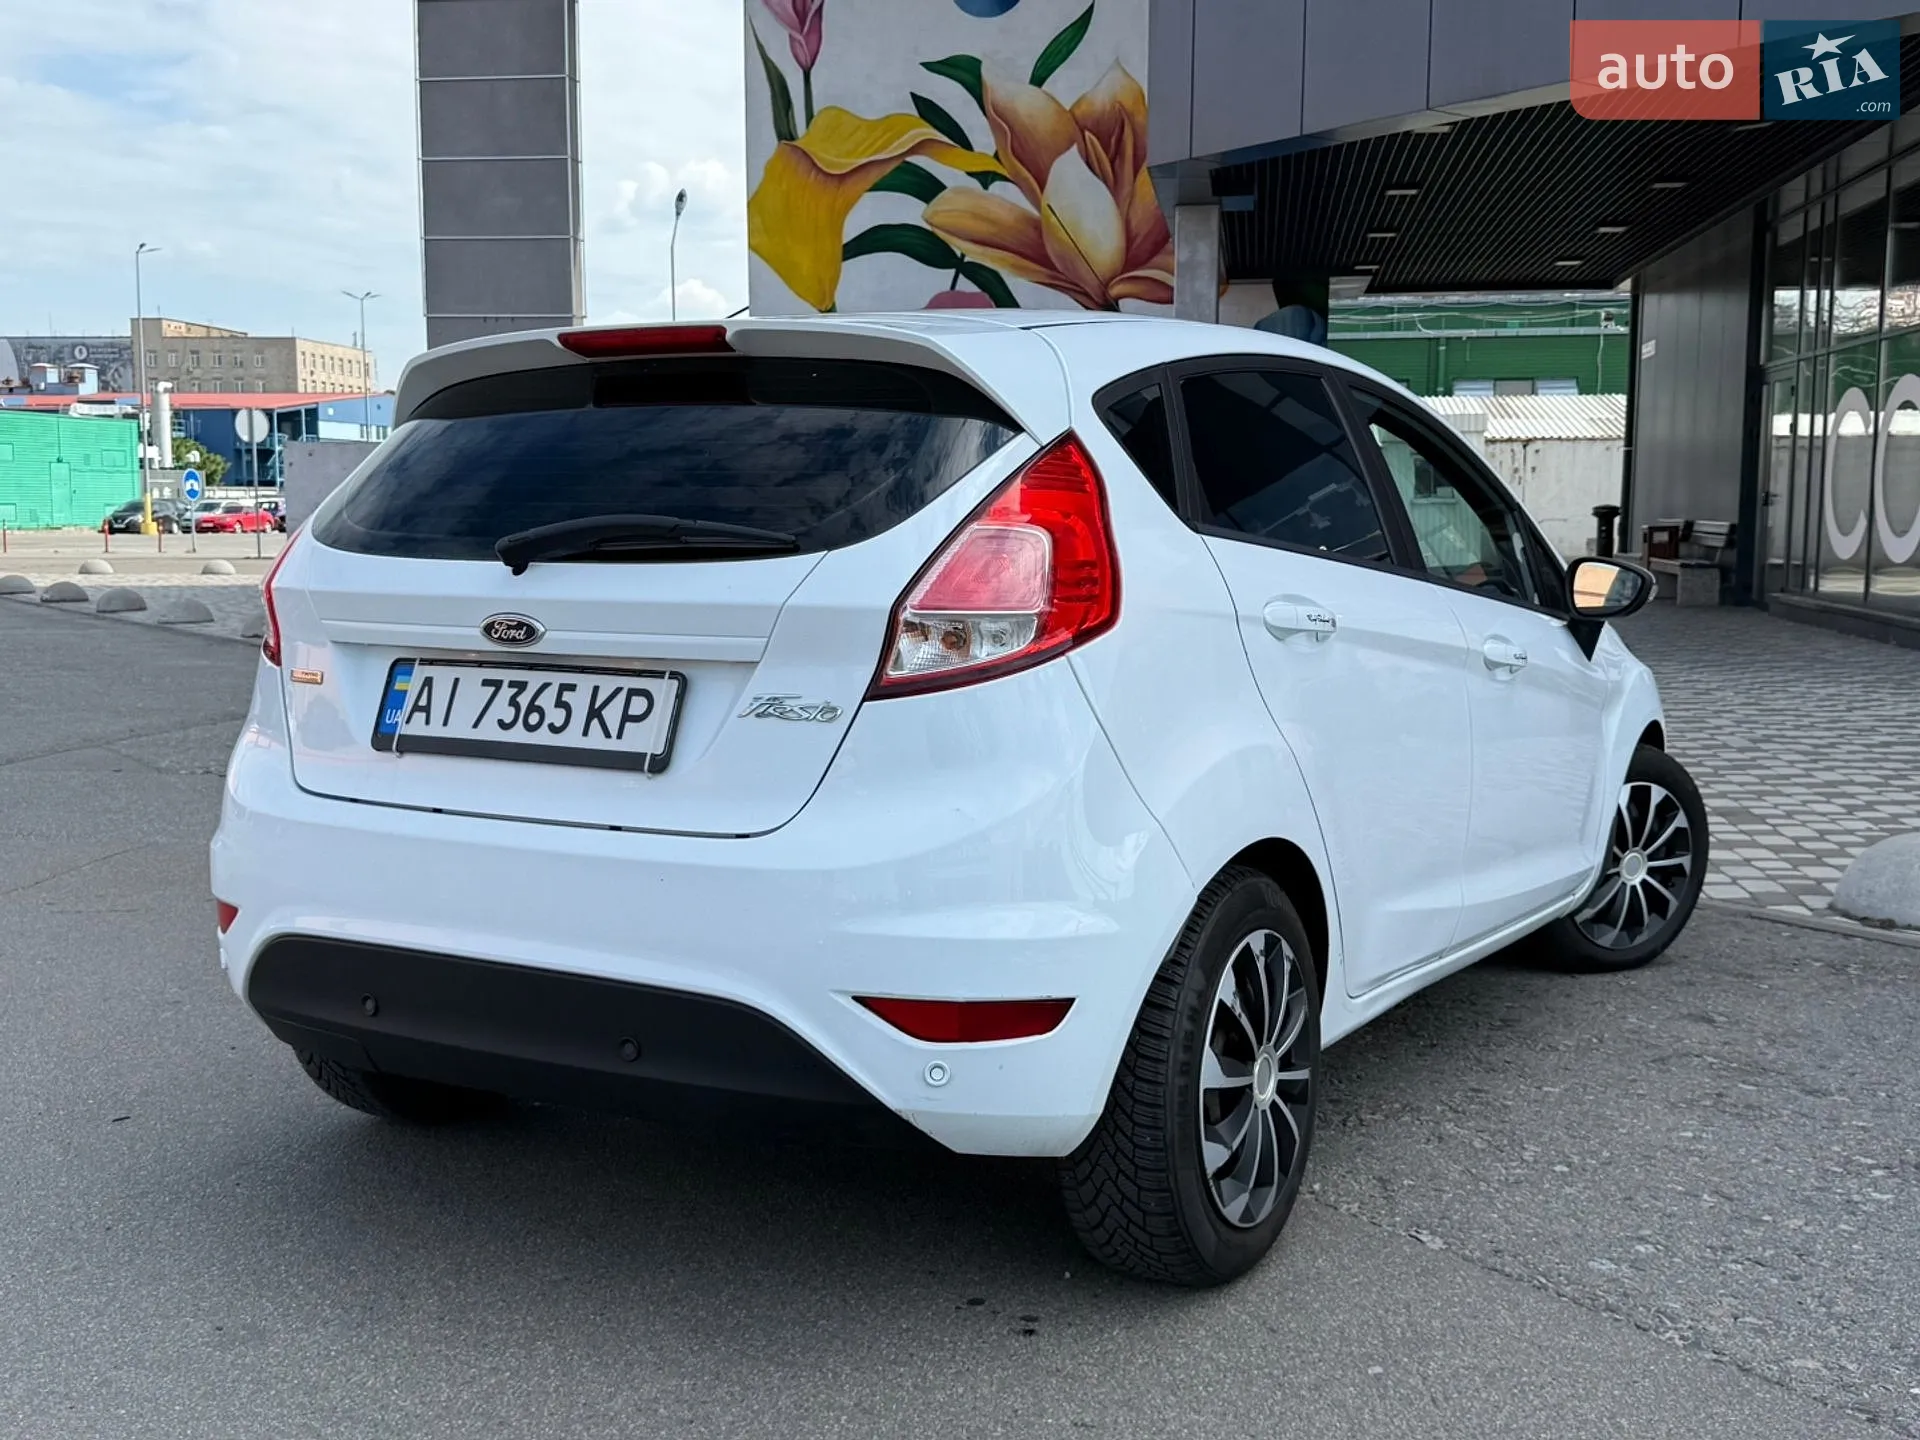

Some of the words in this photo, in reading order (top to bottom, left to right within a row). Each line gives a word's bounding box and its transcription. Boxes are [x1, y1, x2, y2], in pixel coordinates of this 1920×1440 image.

[491, 620, 527, 640] Ford
[405, 676, 460, 727] AI
[472, 679, 577, 734] 7365
[581, 685, 655, 740] KP
[737, 693, 844, 723] Fiesta
